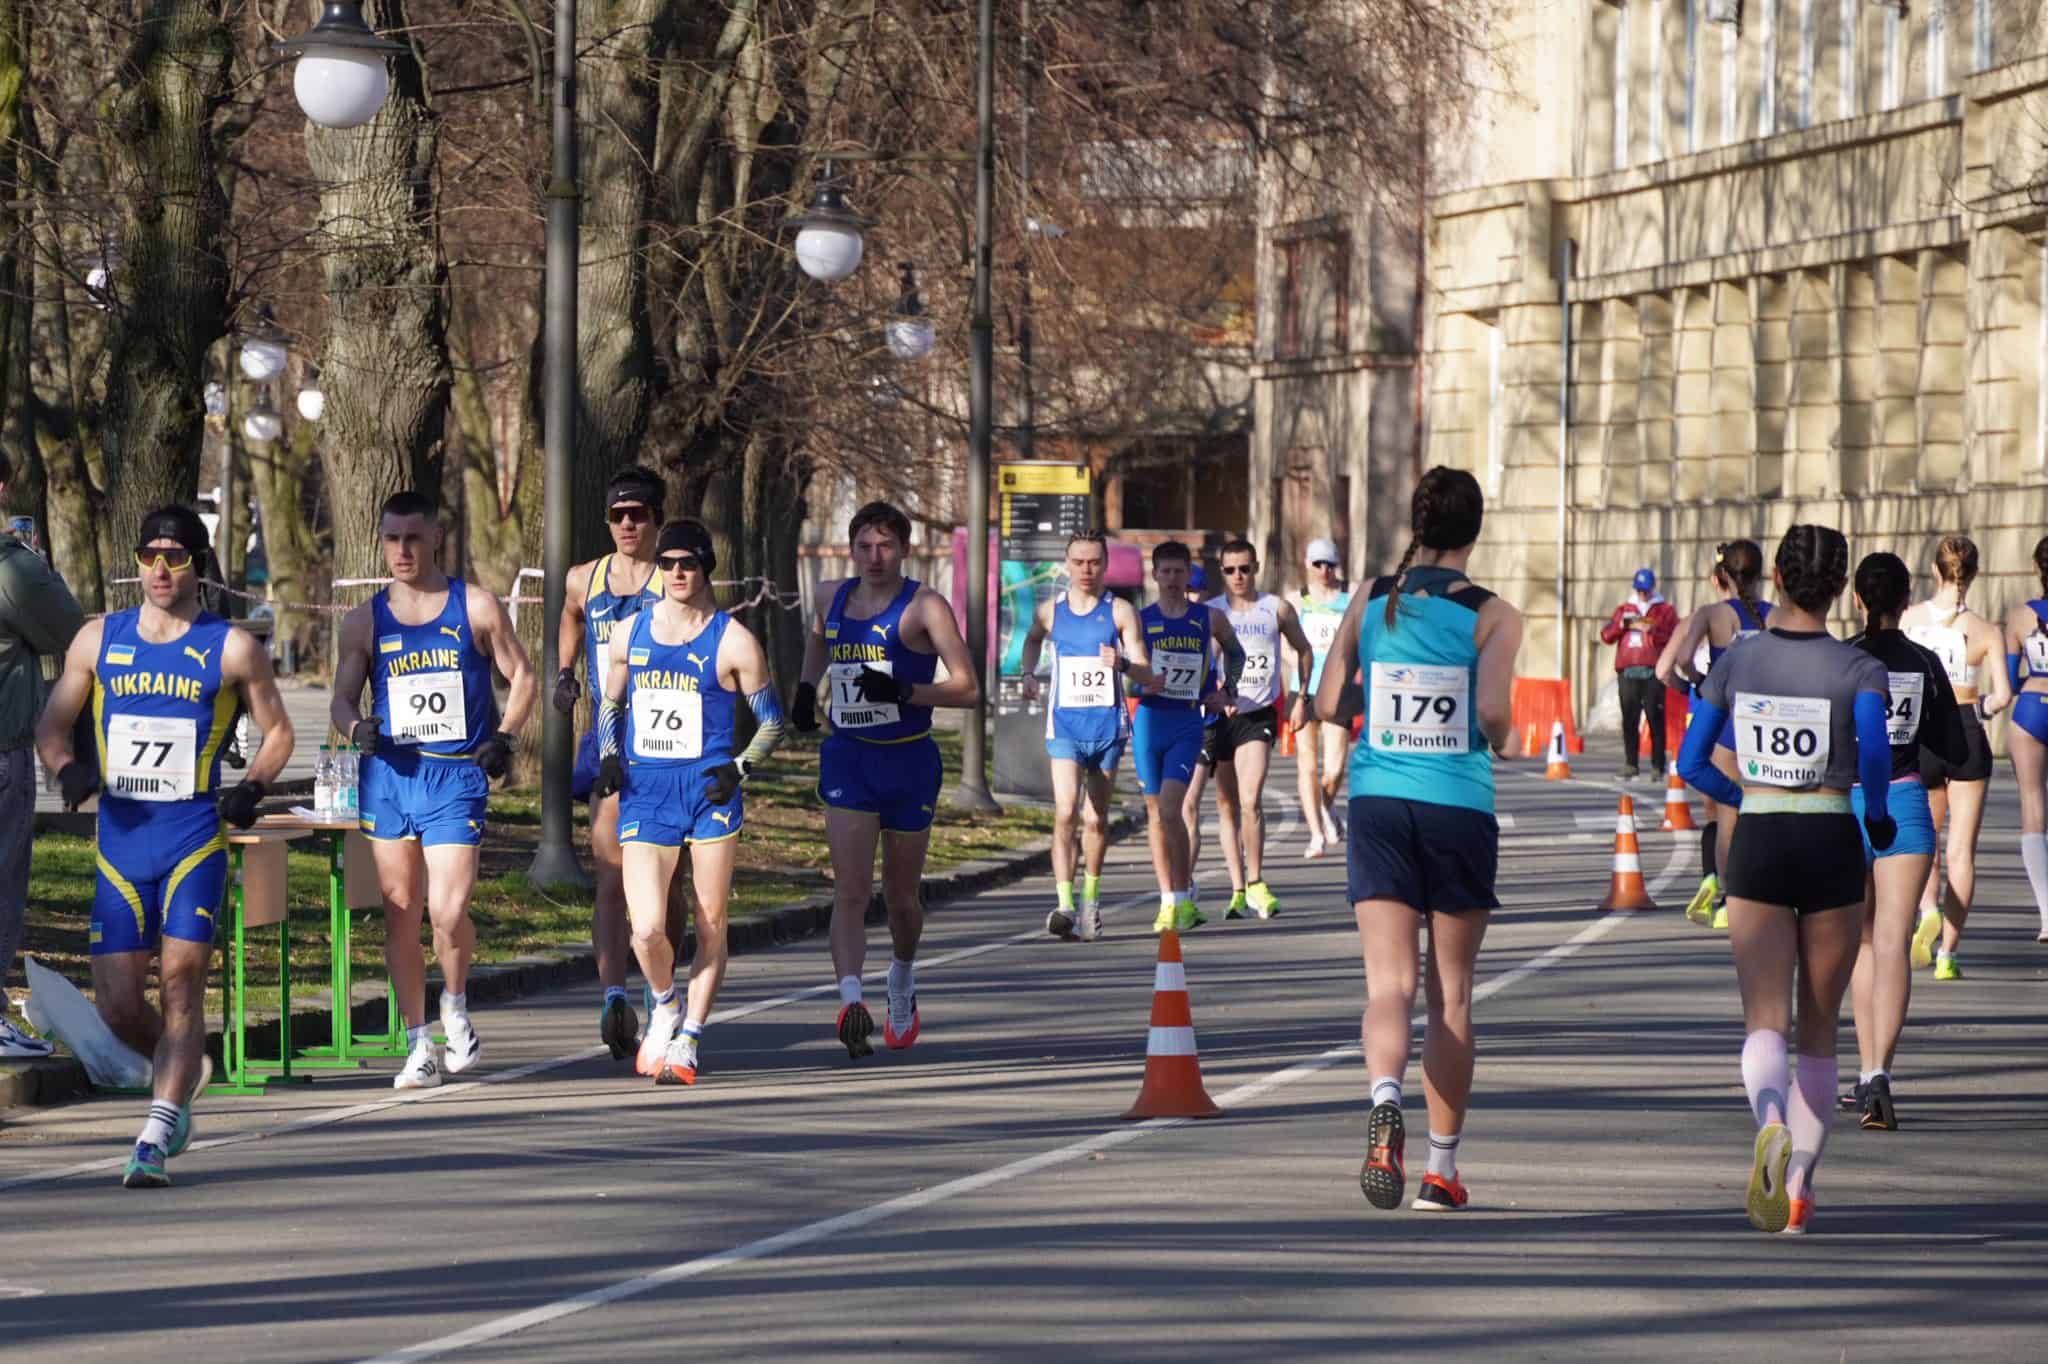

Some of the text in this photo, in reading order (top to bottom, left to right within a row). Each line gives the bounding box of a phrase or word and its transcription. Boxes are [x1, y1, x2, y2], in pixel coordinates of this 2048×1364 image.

[1152, 636, 1201, 652] UKRAINE
[387, 648, 460, 677] UKRAINE
[1246, 655, 1268, 669] 52
[110, 671, 203, 703] UKRAINE
[634, 670, 700, 692] UKRAINE
[1072, 671, 1105, 687] 182
[1162, 667, 1197, 685] 77
[841, 681, 865, 703] 17
[409, 691, 447, 716] 90
[1391, 694, 1457, 724] 179
[650, 709, 683, 731] 76
[1398, 733, 1458, 748] Plantin
[1556, 733, 1563, 756] 1
[1753, 725, 1818, 757] 180
[130, 740, 175, 768] 77
[1762, 764, 1817, 781] Plantin
[116, 775, 159, 793] PUMA
